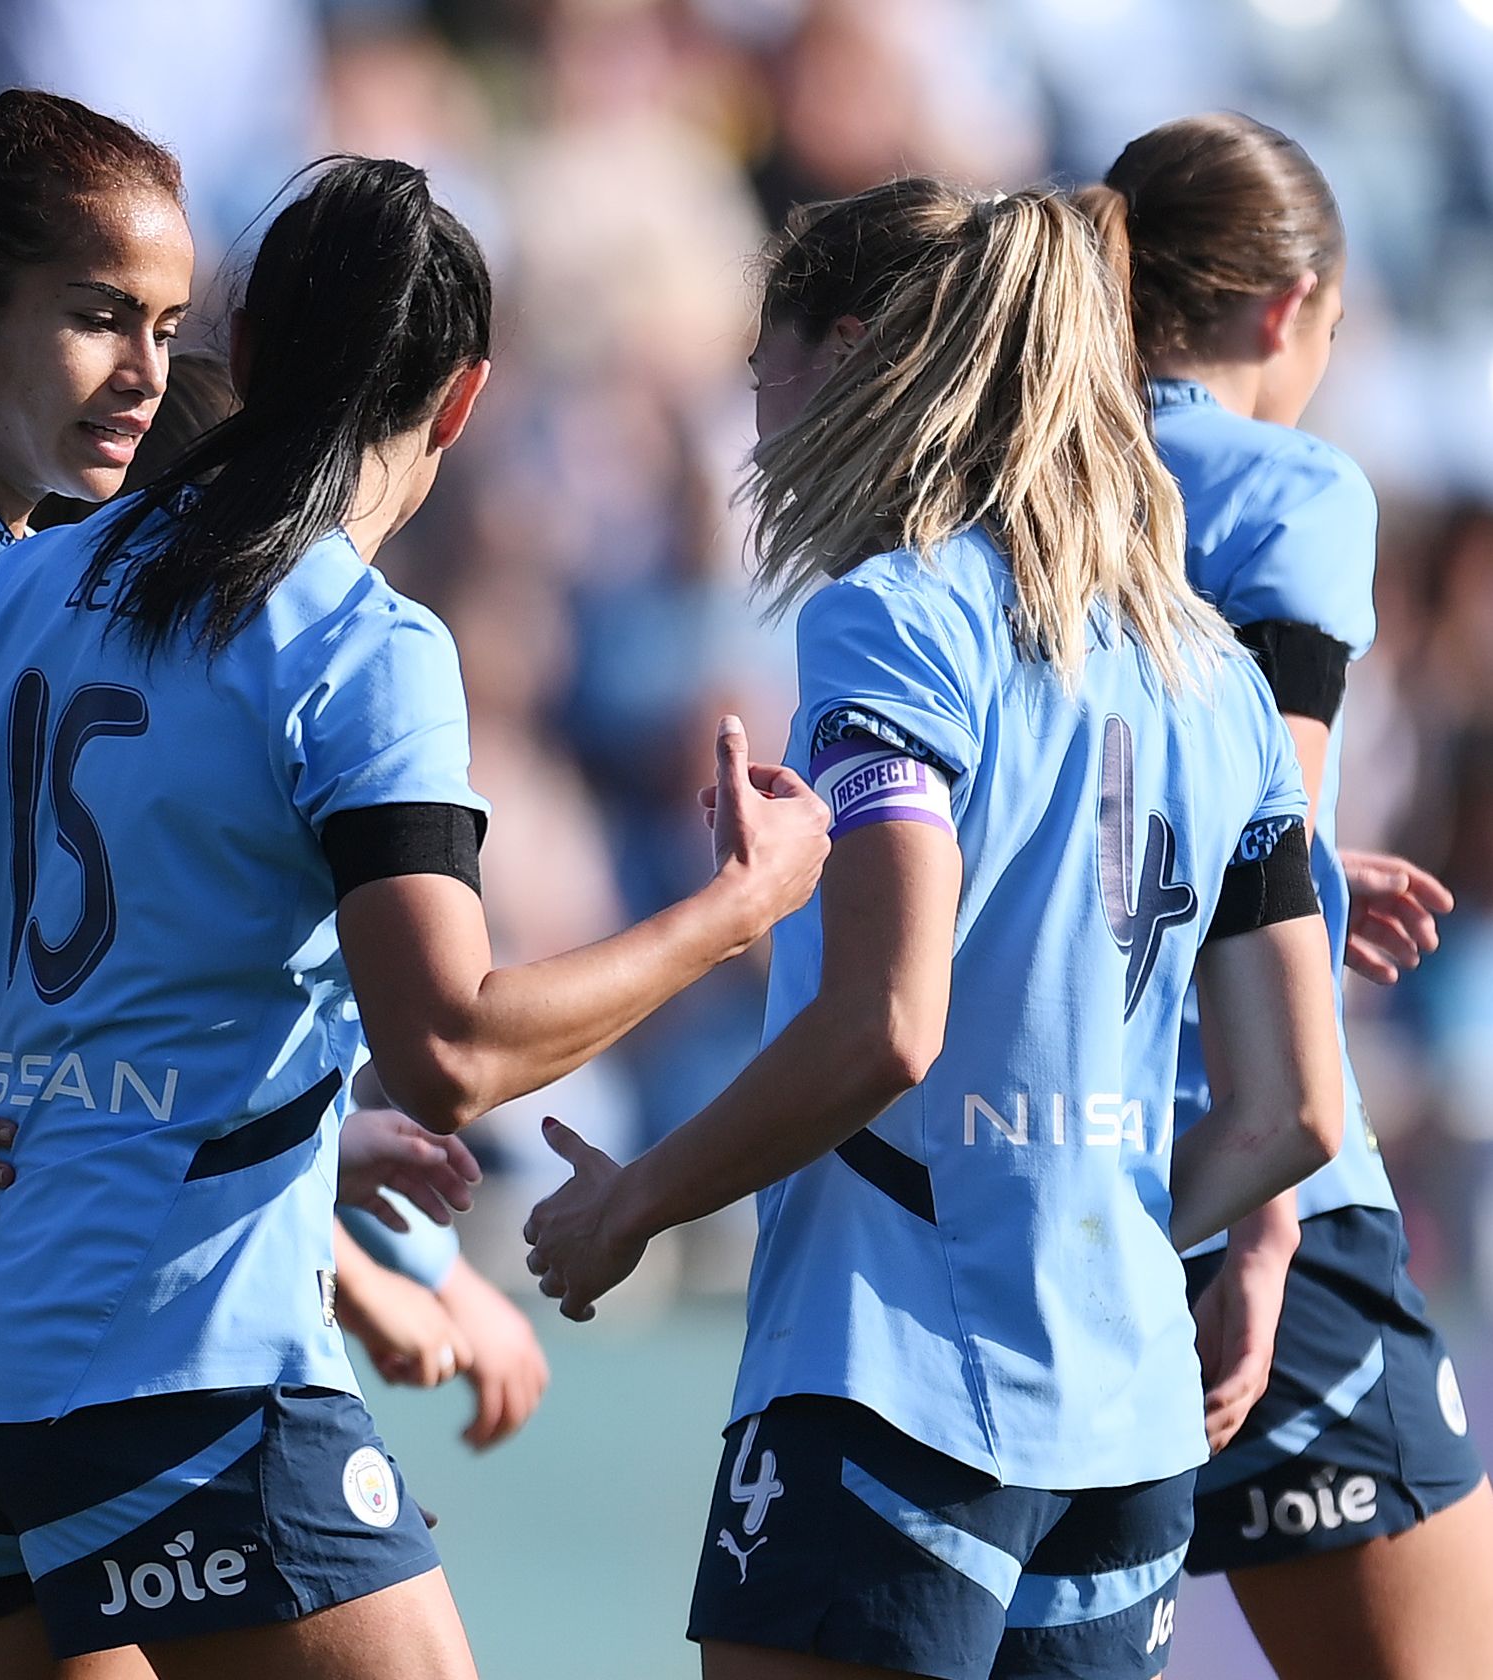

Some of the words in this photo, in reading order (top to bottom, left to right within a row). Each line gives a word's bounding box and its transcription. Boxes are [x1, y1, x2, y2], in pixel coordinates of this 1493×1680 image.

[837, 759, 909, 809] RESPECT
[5, 667, 150, 1006] 15
[1095, 713, 1198, 1025] 4
[730, 1414, 785, 1535] 4
[1242, 1466, 1377, 1540] Joie
[100, 1530, 247, 1615] Joie
